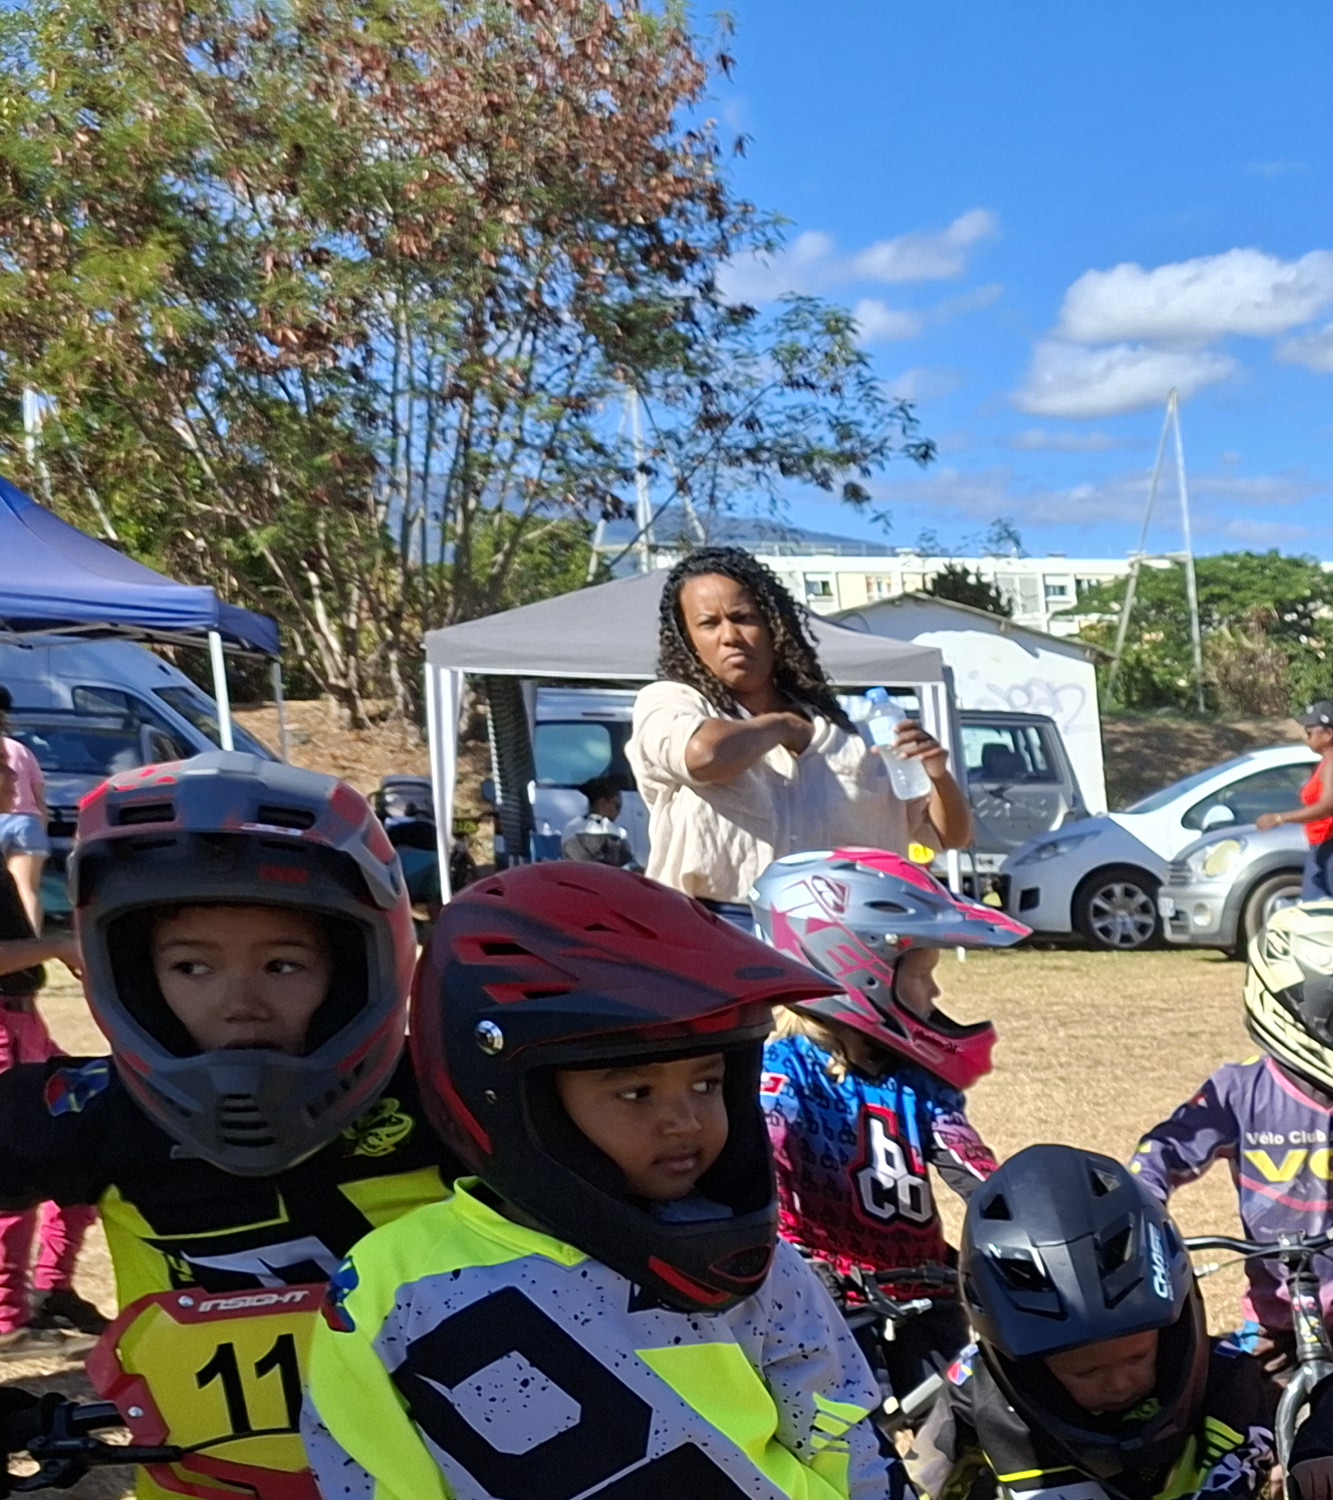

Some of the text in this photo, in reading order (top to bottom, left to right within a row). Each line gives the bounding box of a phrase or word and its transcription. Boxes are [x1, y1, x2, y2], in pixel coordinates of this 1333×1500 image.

[1246, 1131, 1285, 1145] Vélo
[1289, 1129, 1327, 1144] Club
[198, 1290, 309, 1313] INSIGHT
